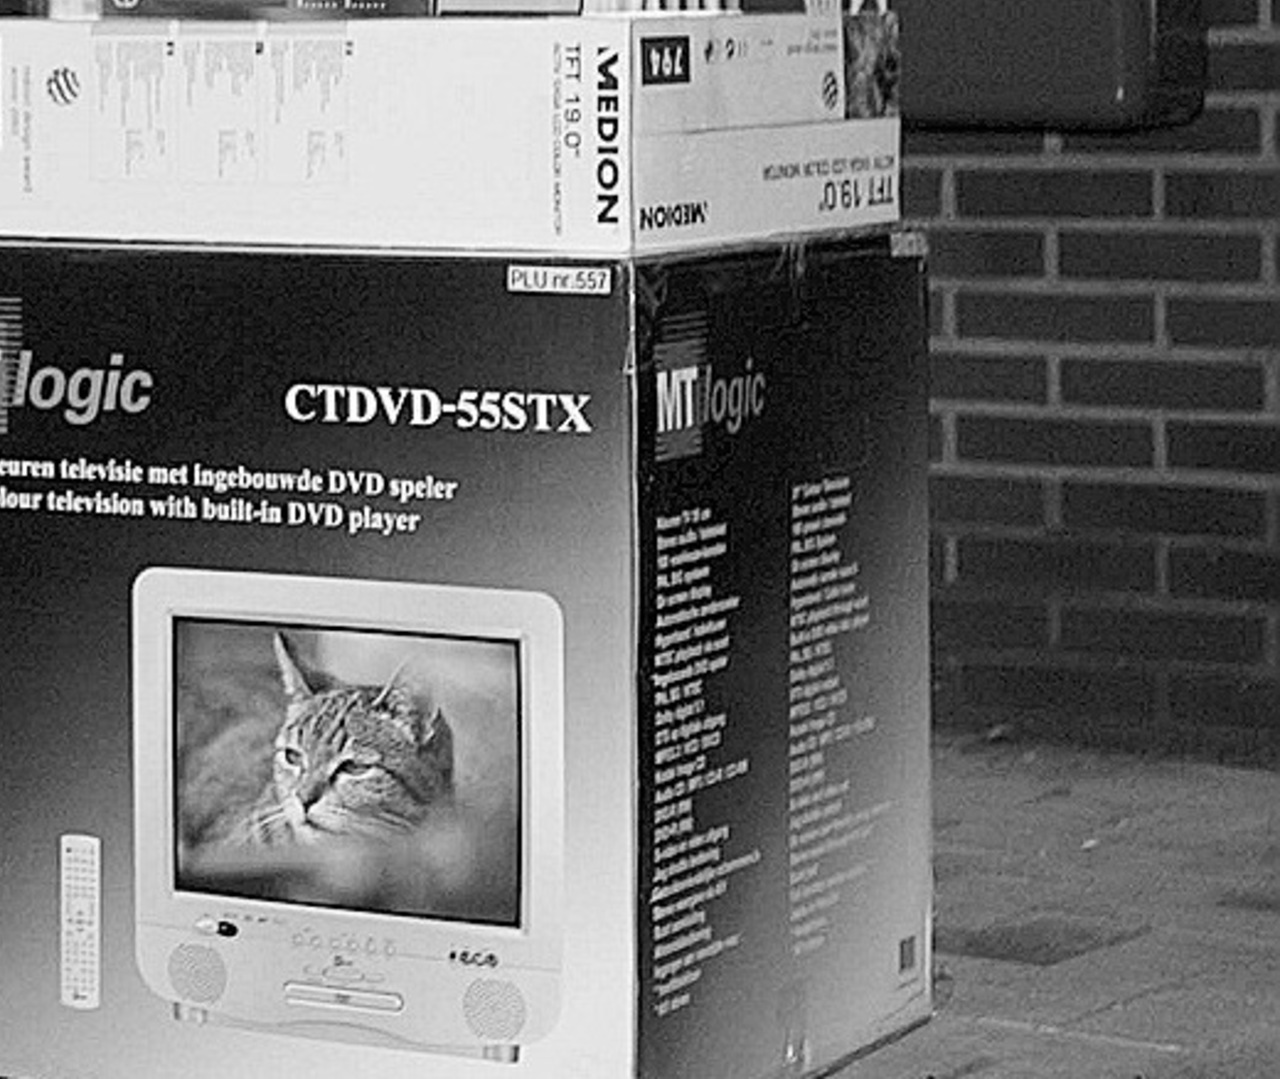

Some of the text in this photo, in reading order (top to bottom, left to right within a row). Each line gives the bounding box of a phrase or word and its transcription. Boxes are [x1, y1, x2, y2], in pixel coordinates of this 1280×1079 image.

[565, 42, 582, 83] TFT
[649, 46, 683, 76] 794
[597, 46, 620, 224] MEDION
[868, 175, 894, 206] TFT
[639, 201, 708, 231] MEDION
[511, 269, 548, 290] PLU
[285, 383, 593, 433] CTDVD-55STX
[59, 457, 144, 483] televisie
[148, 465, 189, 486] met
[193, 463, 324, 493] ingebouwde
[328, 470, 385, 496] DVD
[389, 475, 459, 504] speler
[46, 489, 145, 516] television
[149, 494, 198, 519] with
[201, 497, 283, 524] built-in
[287, 501, 344, 527] DVD
[348, 505, 421, 536] player
